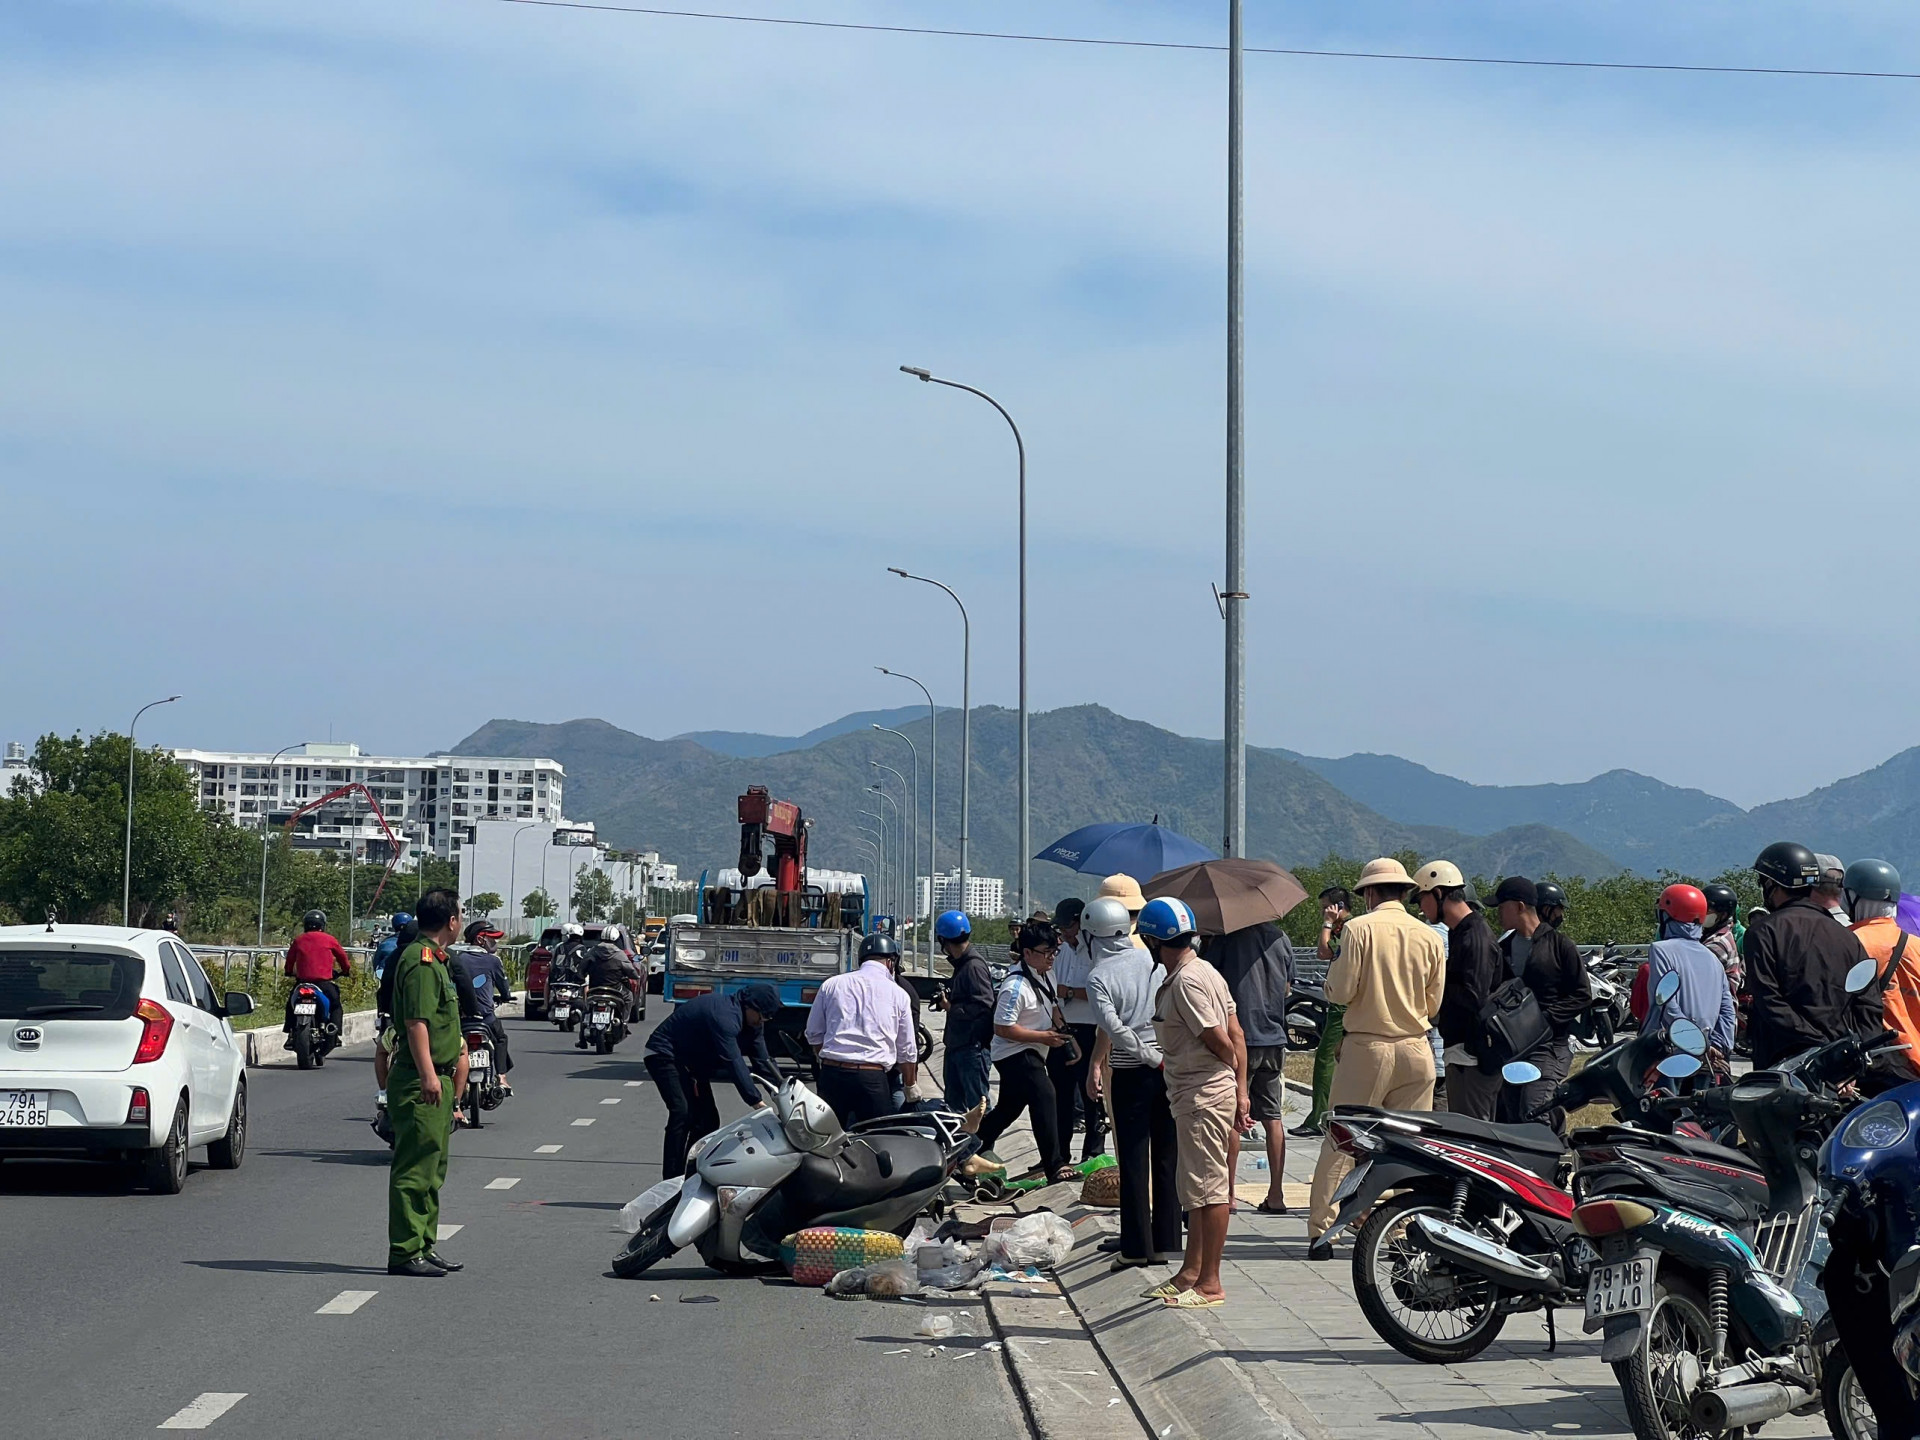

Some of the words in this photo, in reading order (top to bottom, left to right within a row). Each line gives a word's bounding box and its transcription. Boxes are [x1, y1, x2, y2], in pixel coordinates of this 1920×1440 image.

[19, 1031, 37, 1039] KIA
[9, 1093, 36, 1109] 79A
[0, 1110, 46, 1126] 245.85
[1423, 1143, 1492, 1169] BLADE
[1593, 1262, 1643, 1291] 79-N8
[1593, 1285, 1642, 1314] 3440
